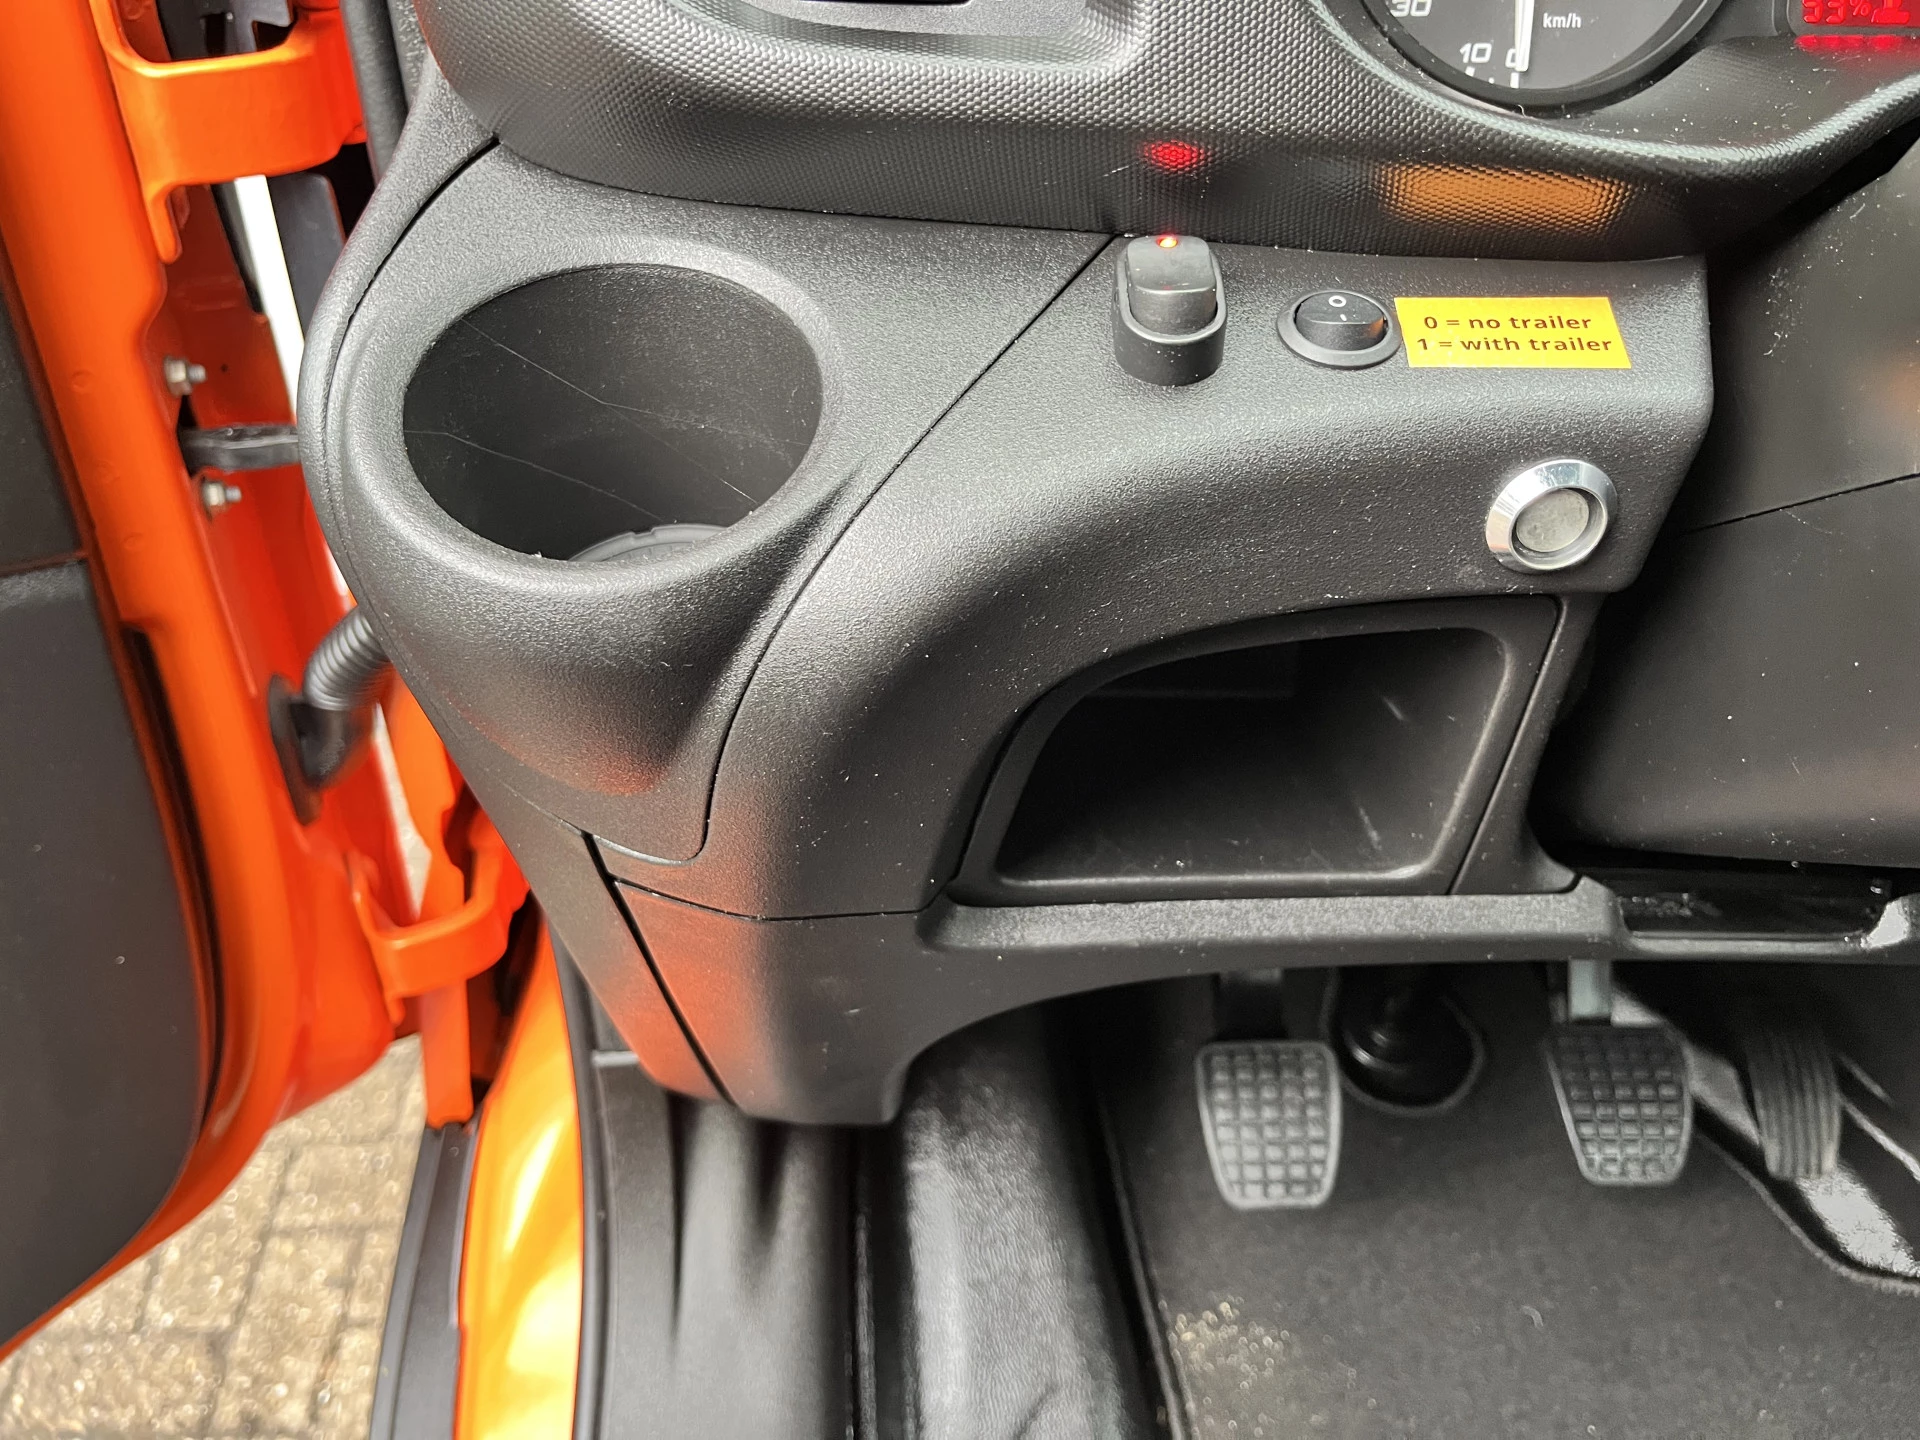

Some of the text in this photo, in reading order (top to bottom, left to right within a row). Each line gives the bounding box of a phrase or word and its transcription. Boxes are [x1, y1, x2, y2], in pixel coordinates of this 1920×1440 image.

[1390, 0, 1431, 17] 30
[1543, 13, 1582, 28] km/h
[1460, 43, 1492, 63] 10
[1424, 316, 1438, 329] 0
[1469, 319, 1501, 329] no
[1509, 315, 1591, 329] trailer
[1417, 338, 1428, 350] 1
[1460, 337, 1520, 351] with
[1528, 337, 1612, 351] trailer
